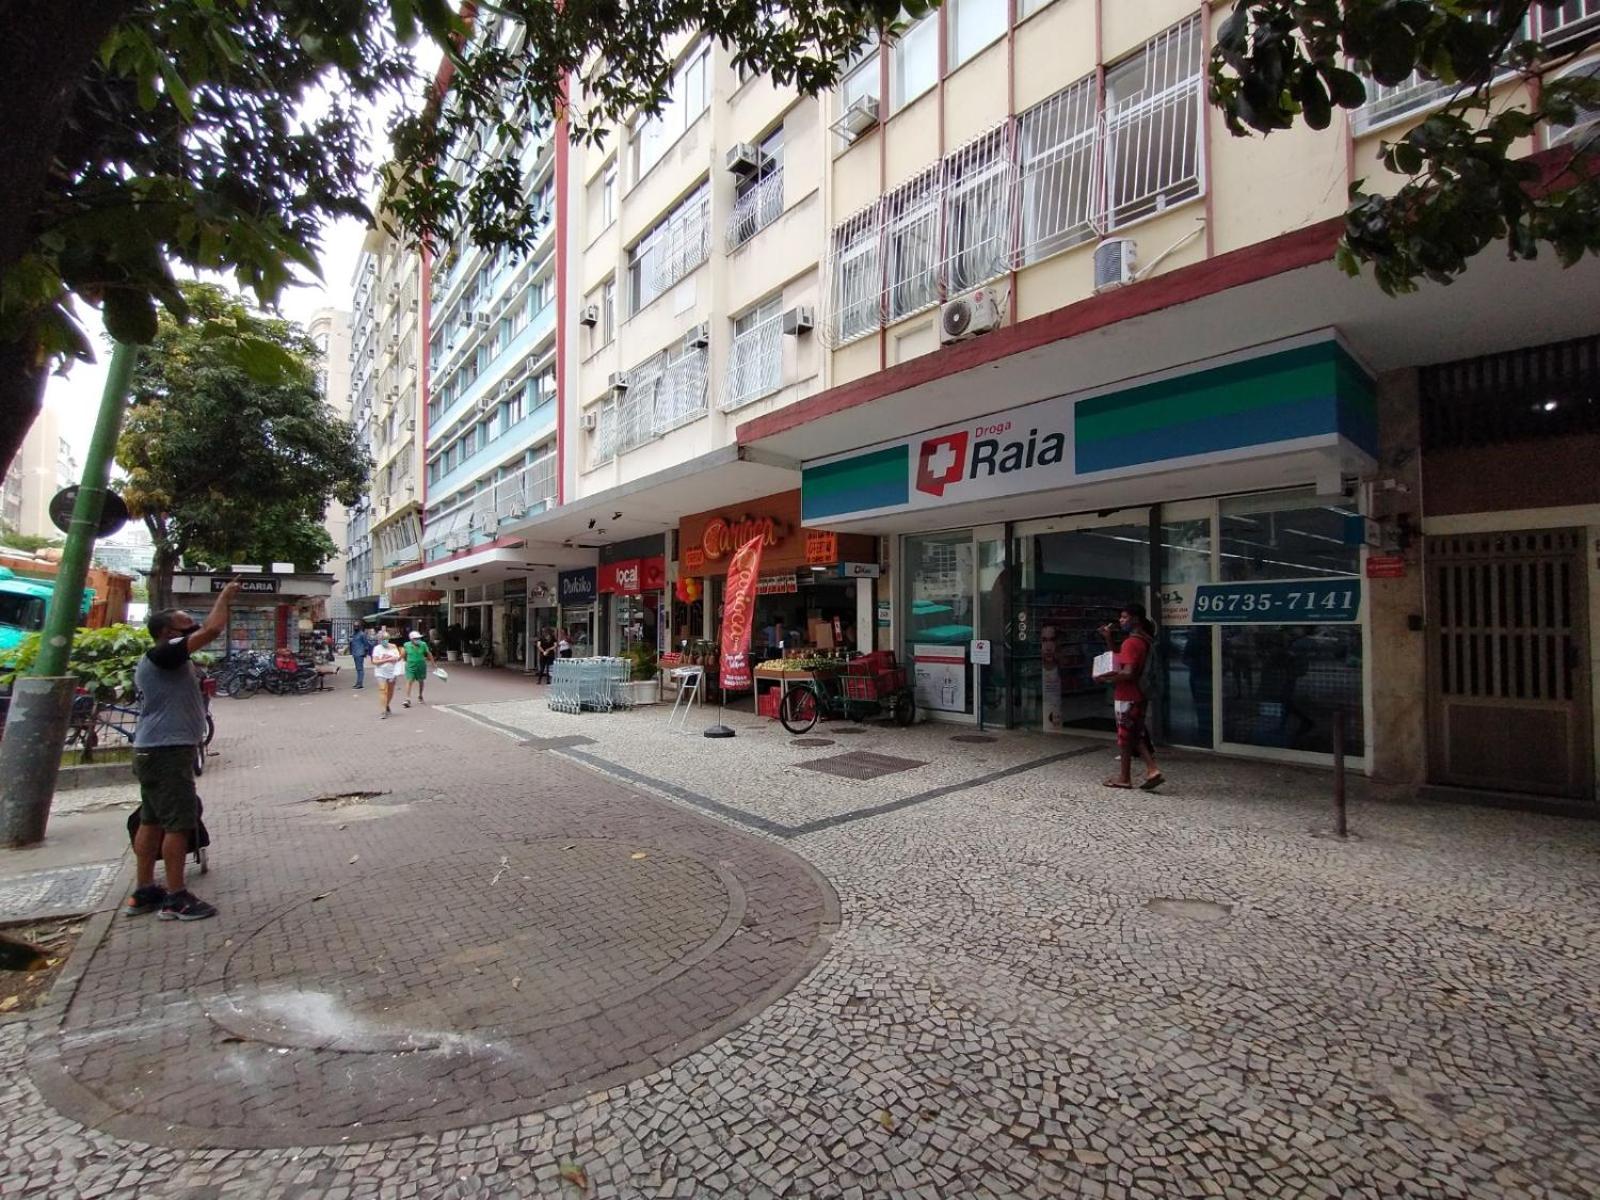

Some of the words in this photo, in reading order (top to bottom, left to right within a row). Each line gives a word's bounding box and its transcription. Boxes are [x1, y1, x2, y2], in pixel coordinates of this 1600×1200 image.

[975, 420, 1012, 438] Droga
[969, 428, 1065, 479] Raia
[213, 581, 274, 591] TACARIA
[615, 565, 638, 587] local
[730, 549, 757, 641] Carioca
[1197, 591, 1353, 612] 96735-7141
